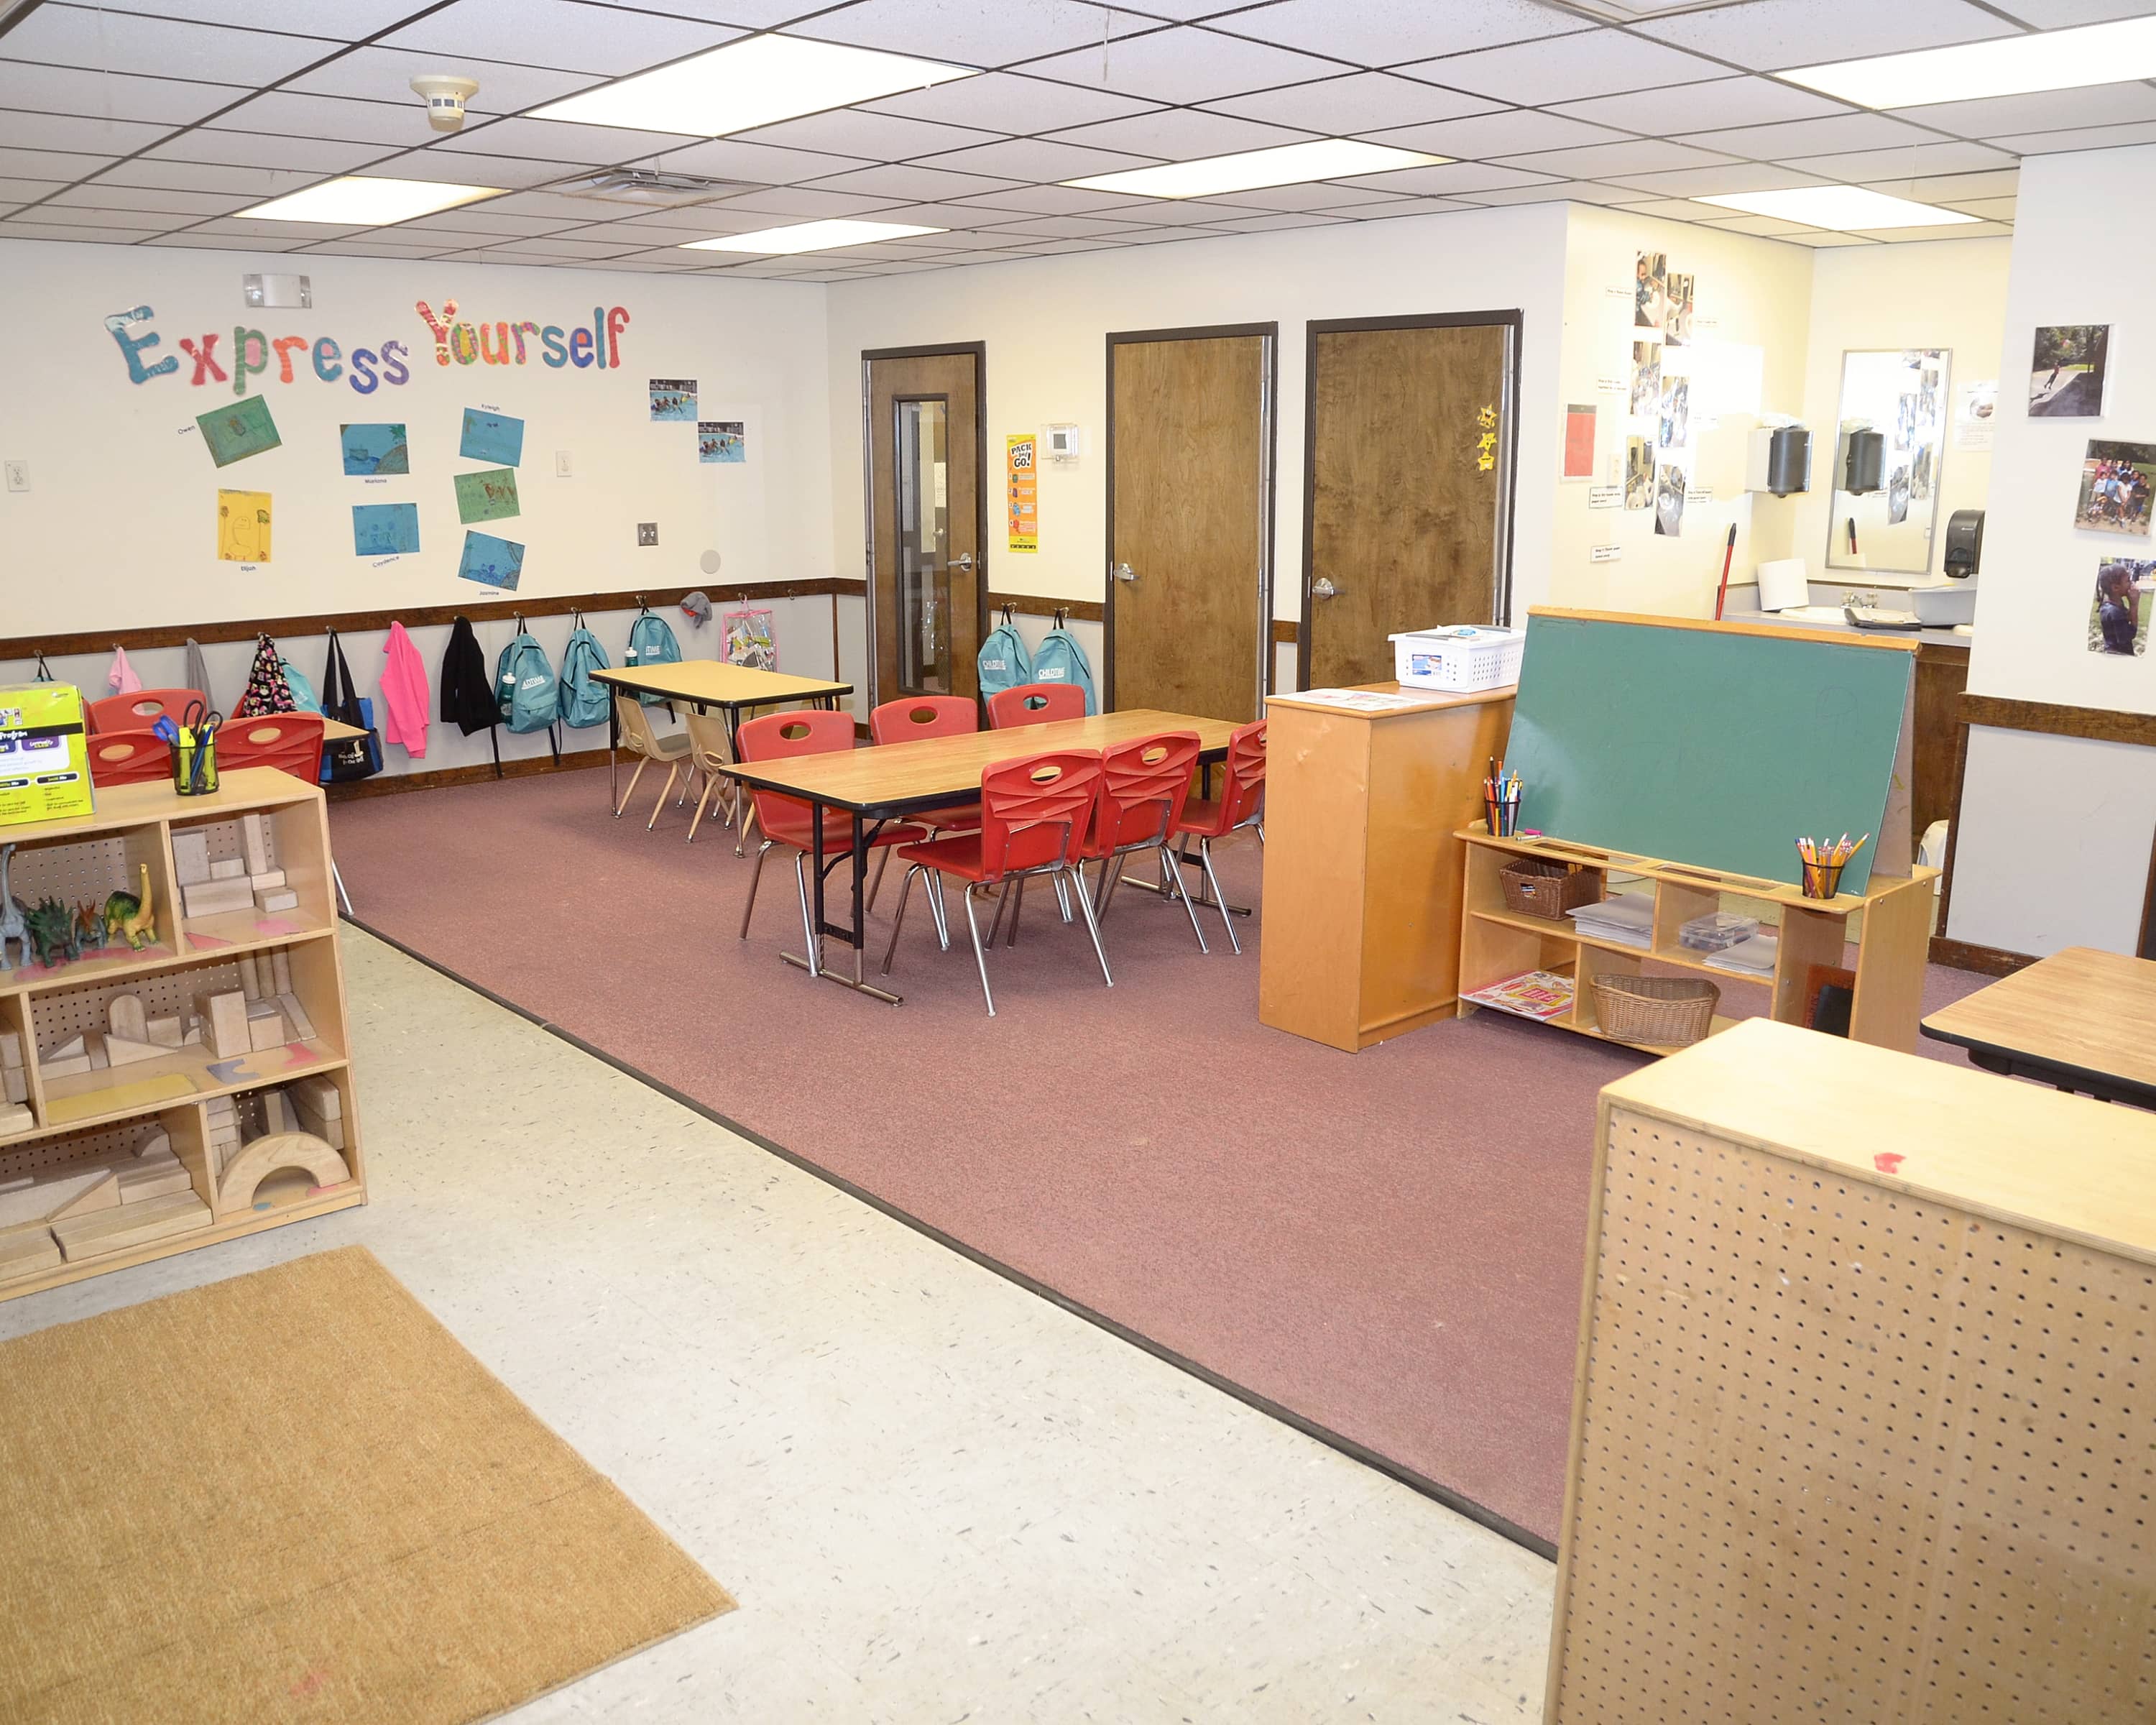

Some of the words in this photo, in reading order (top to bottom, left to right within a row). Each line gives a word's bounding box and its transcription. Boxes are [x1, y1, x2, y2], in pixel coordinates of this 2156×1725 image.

[103, 305, 410, 395] Express
[415, 299, 630, 369] Yourself
[178, 426, 195, 435] Owen
[1011, 443, 1032, 455] PACK
[1014, 453, 1031, 467] GO!
[1038, 667, 1065, 677] CHILDTIME
